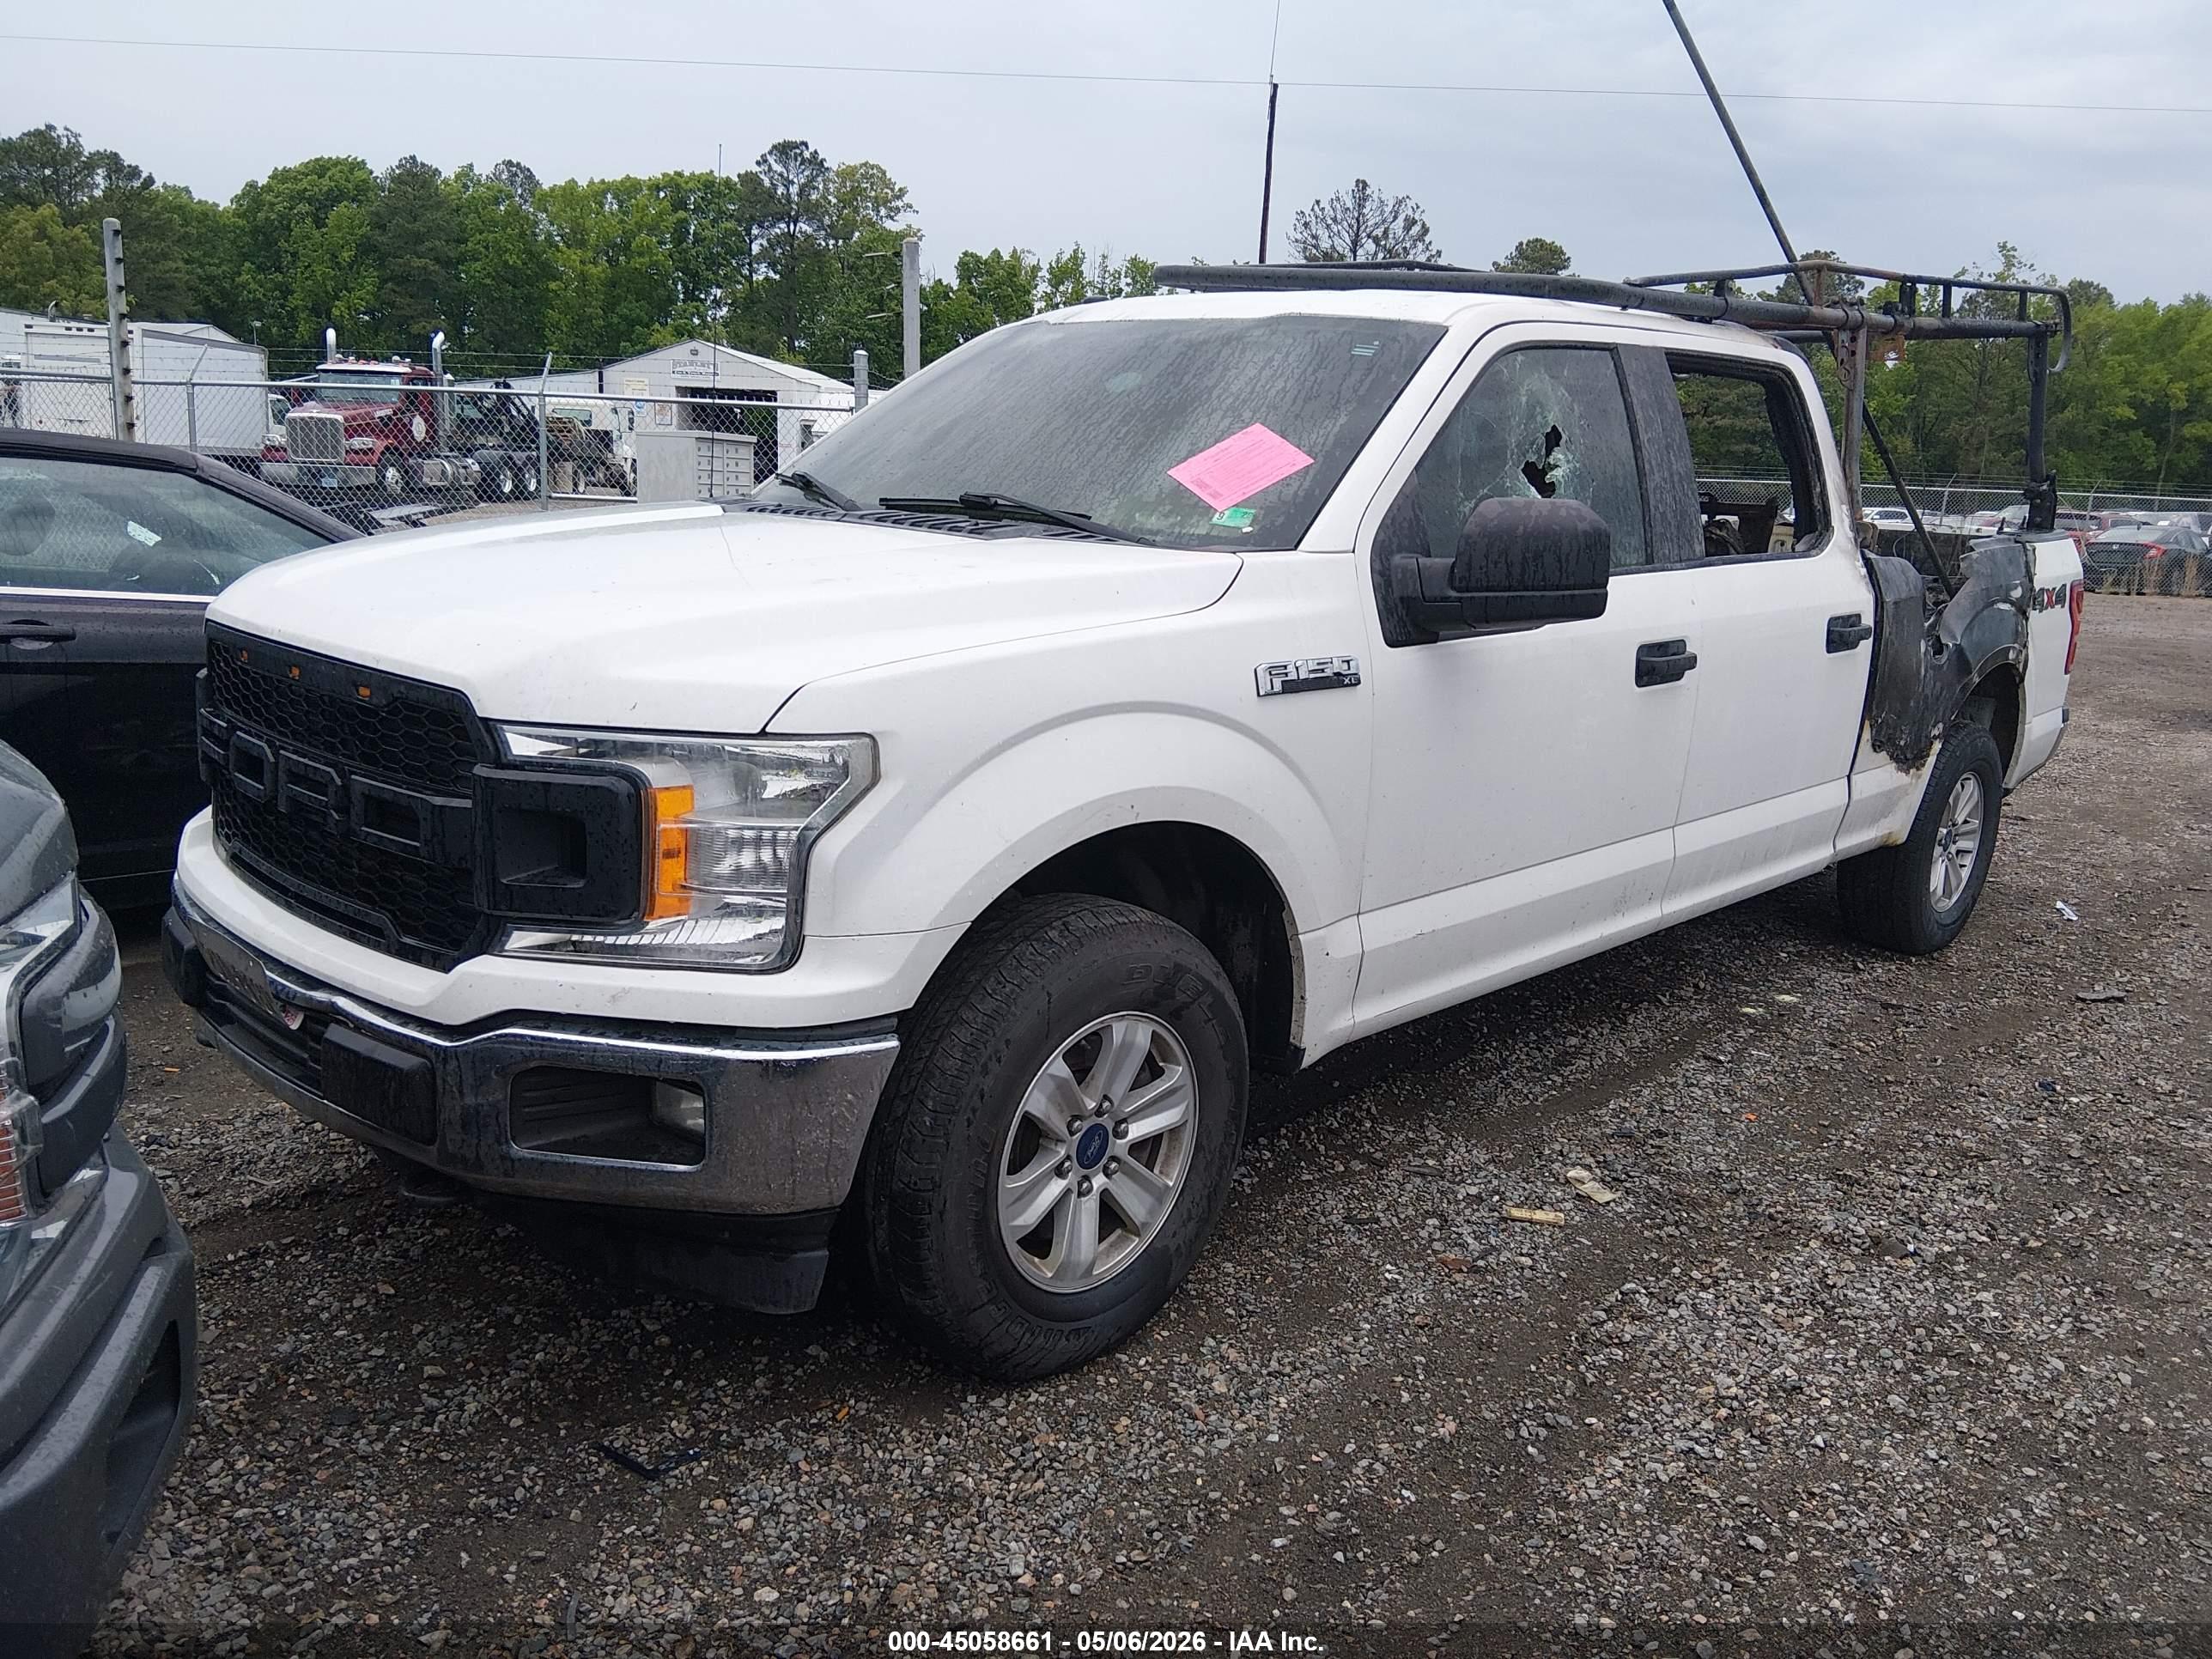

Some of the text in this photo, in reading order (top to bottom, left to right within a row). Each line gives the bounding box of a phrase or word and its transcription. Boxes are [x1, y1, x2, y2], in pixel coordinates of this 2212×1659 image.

[1254, 654, 1361, 697] F150
[1343, 675, 1359, 685] XL
[198, 707, 431, 847] FORD
